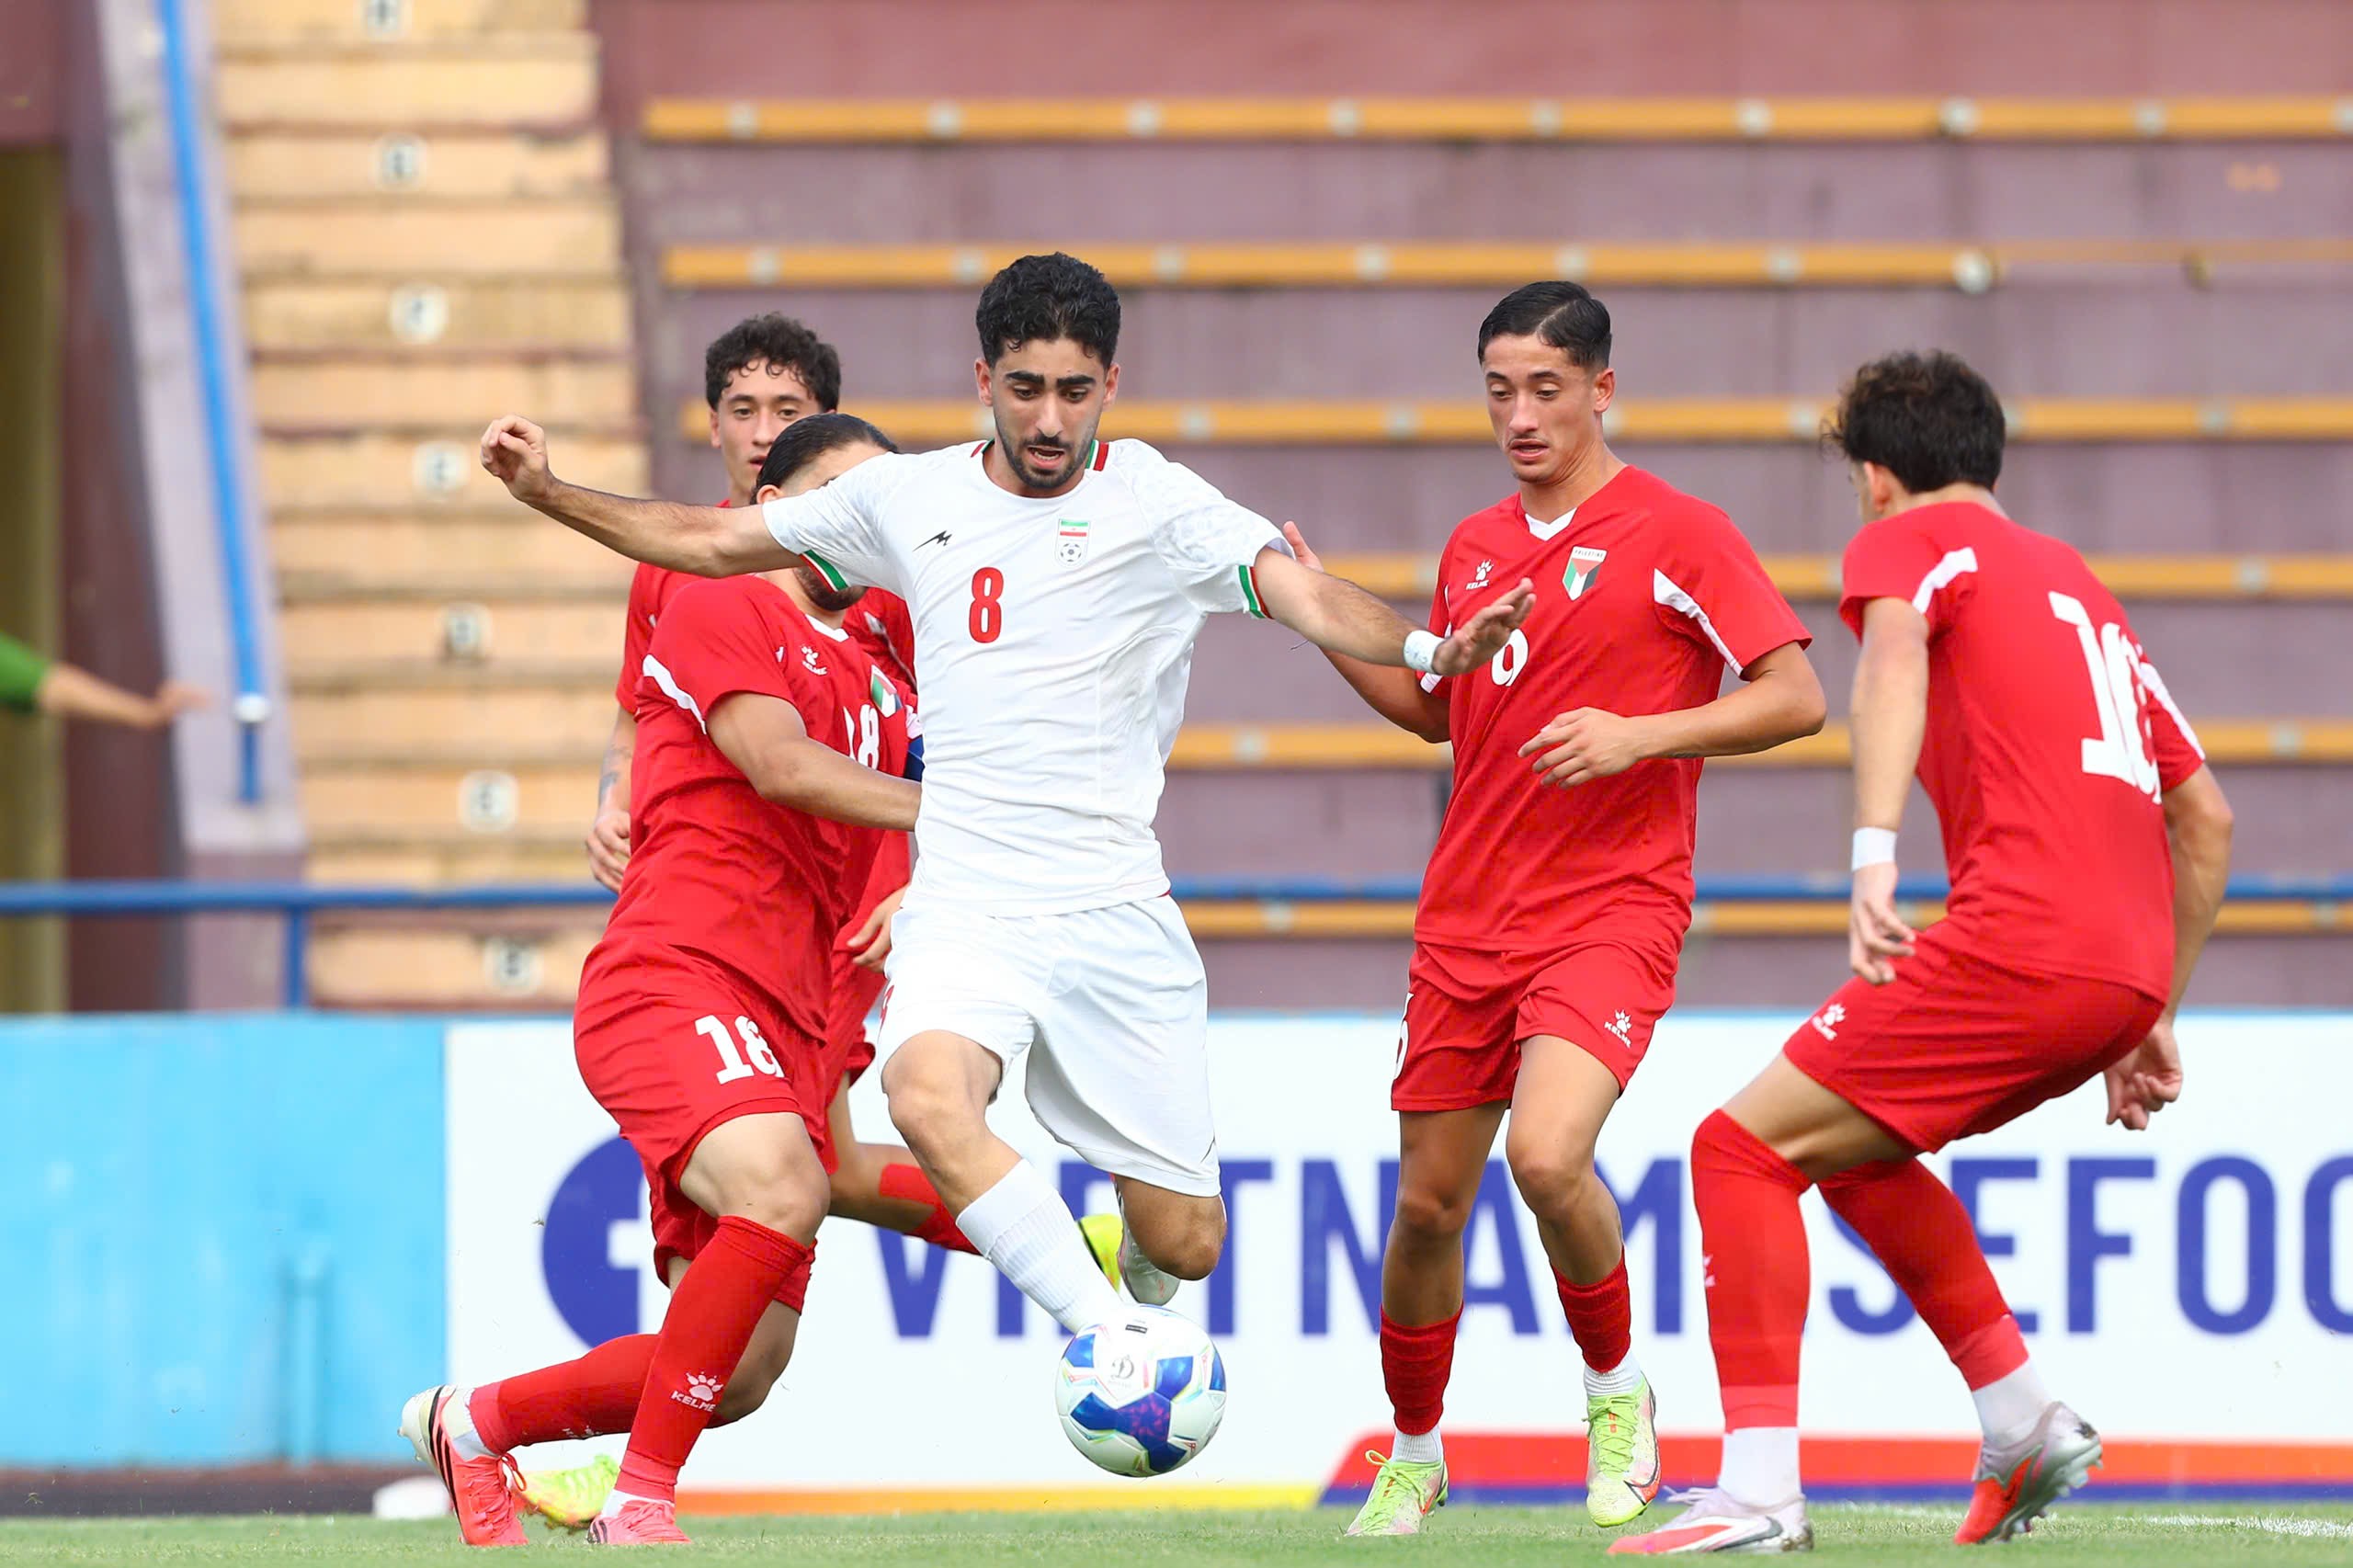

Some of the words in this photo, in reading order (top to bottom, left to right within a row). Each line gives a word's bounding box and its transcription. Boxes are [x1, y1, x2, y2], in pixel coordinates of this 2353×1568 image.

[969, 567, 1004, 643] 8
[2048, 591, 2162, 805] 10
[695, 1015, 785, 1085] 18
[1604, 1021, 1631, 1049] KELME
[671, 1391, 716, 1413] KELME
